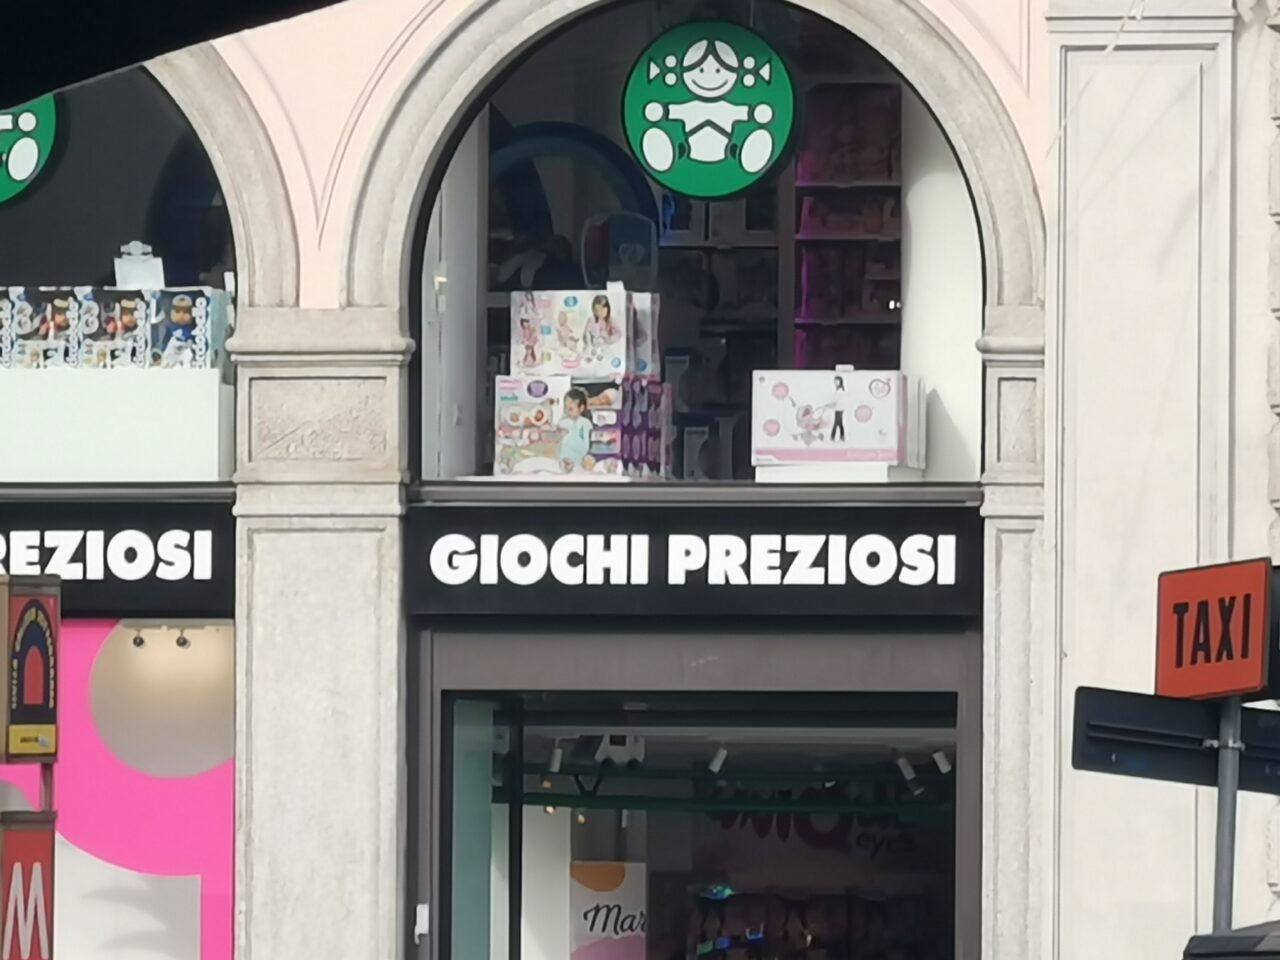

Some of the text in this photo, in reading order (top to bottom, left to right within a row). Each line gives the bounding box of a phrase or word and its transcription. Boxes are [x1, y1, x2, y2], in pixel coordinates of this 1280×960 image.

[0, 529, 212, 581] EZIOSI
[429, 533, 956, 586] GIOCHI PREZIOSI
[1173, 593, 1252, 669] TAXI
